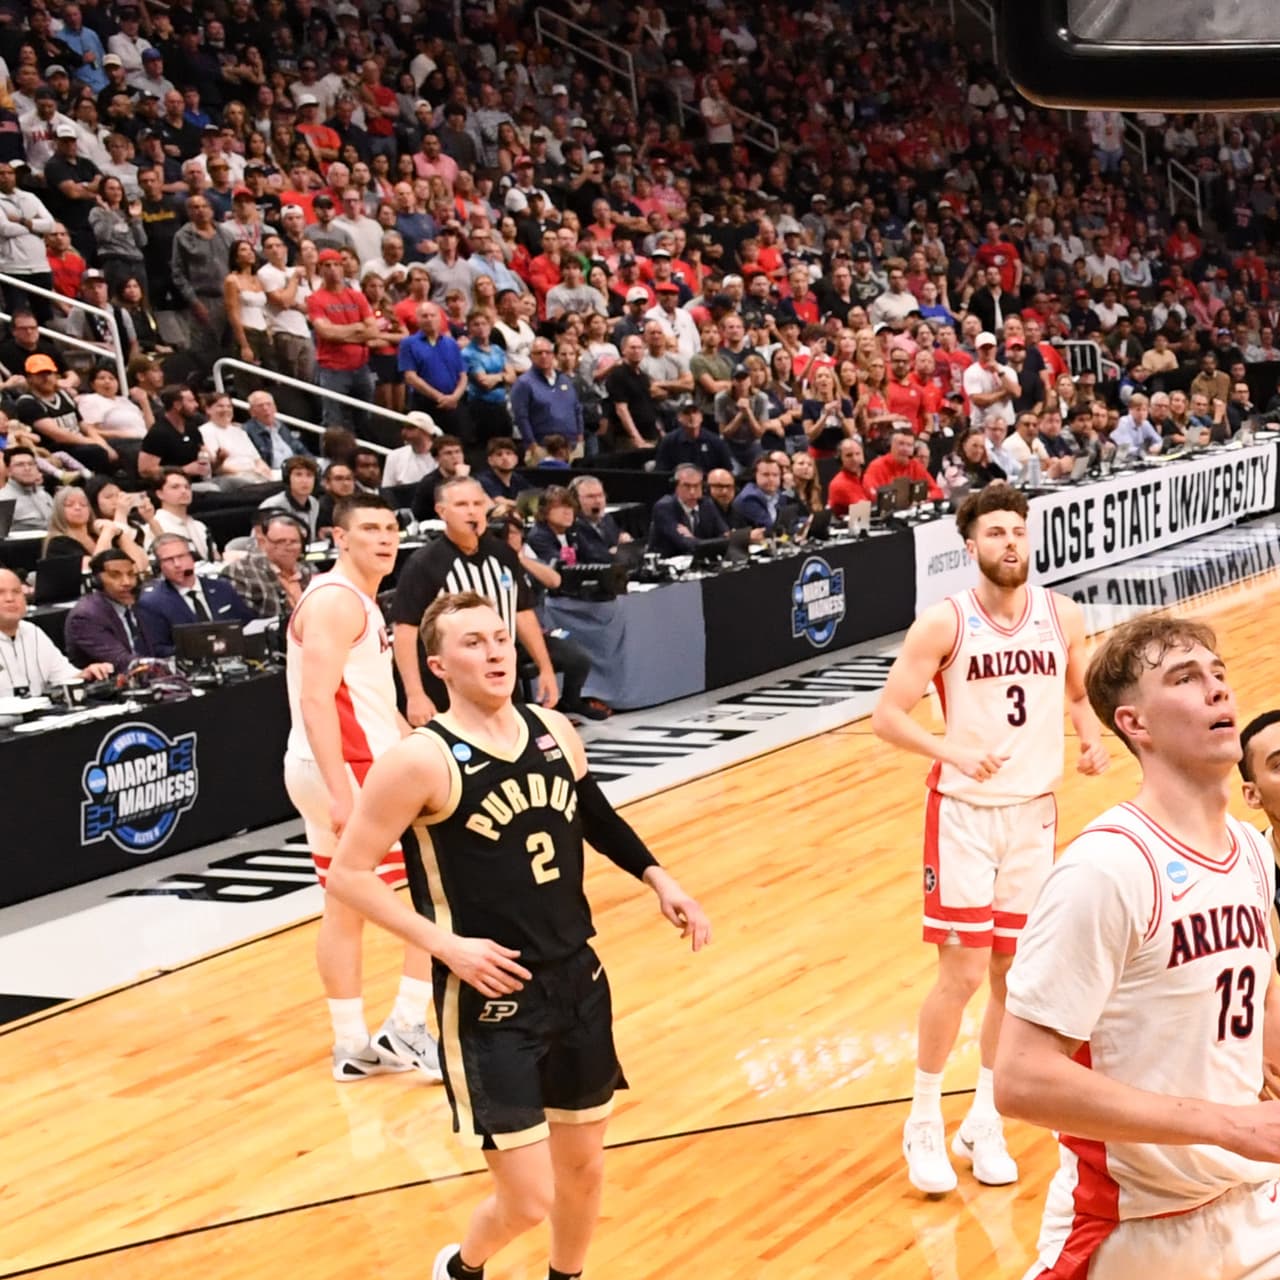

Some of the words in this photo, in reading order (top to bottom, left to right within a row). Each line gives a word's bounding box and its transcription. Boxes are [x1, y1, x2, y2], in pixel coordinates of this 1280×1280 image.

[1036, 498, 1095, 574] JOSE
[1103, 481, 1162, 554] STATE
[1168, 454, 1271, 533] UNIVERSITY
[966, 649, 1057, 682] ARIZONA
[1006, 685, 1027, 727] 3
[106, 751, 167, 792] MARCH
[118, 770, 194, 817] MADNESS
[526, 831, 561, 885] 2
[479, 1001, 518, 1022] P
[1215, 965, 1255, 1041] 13
